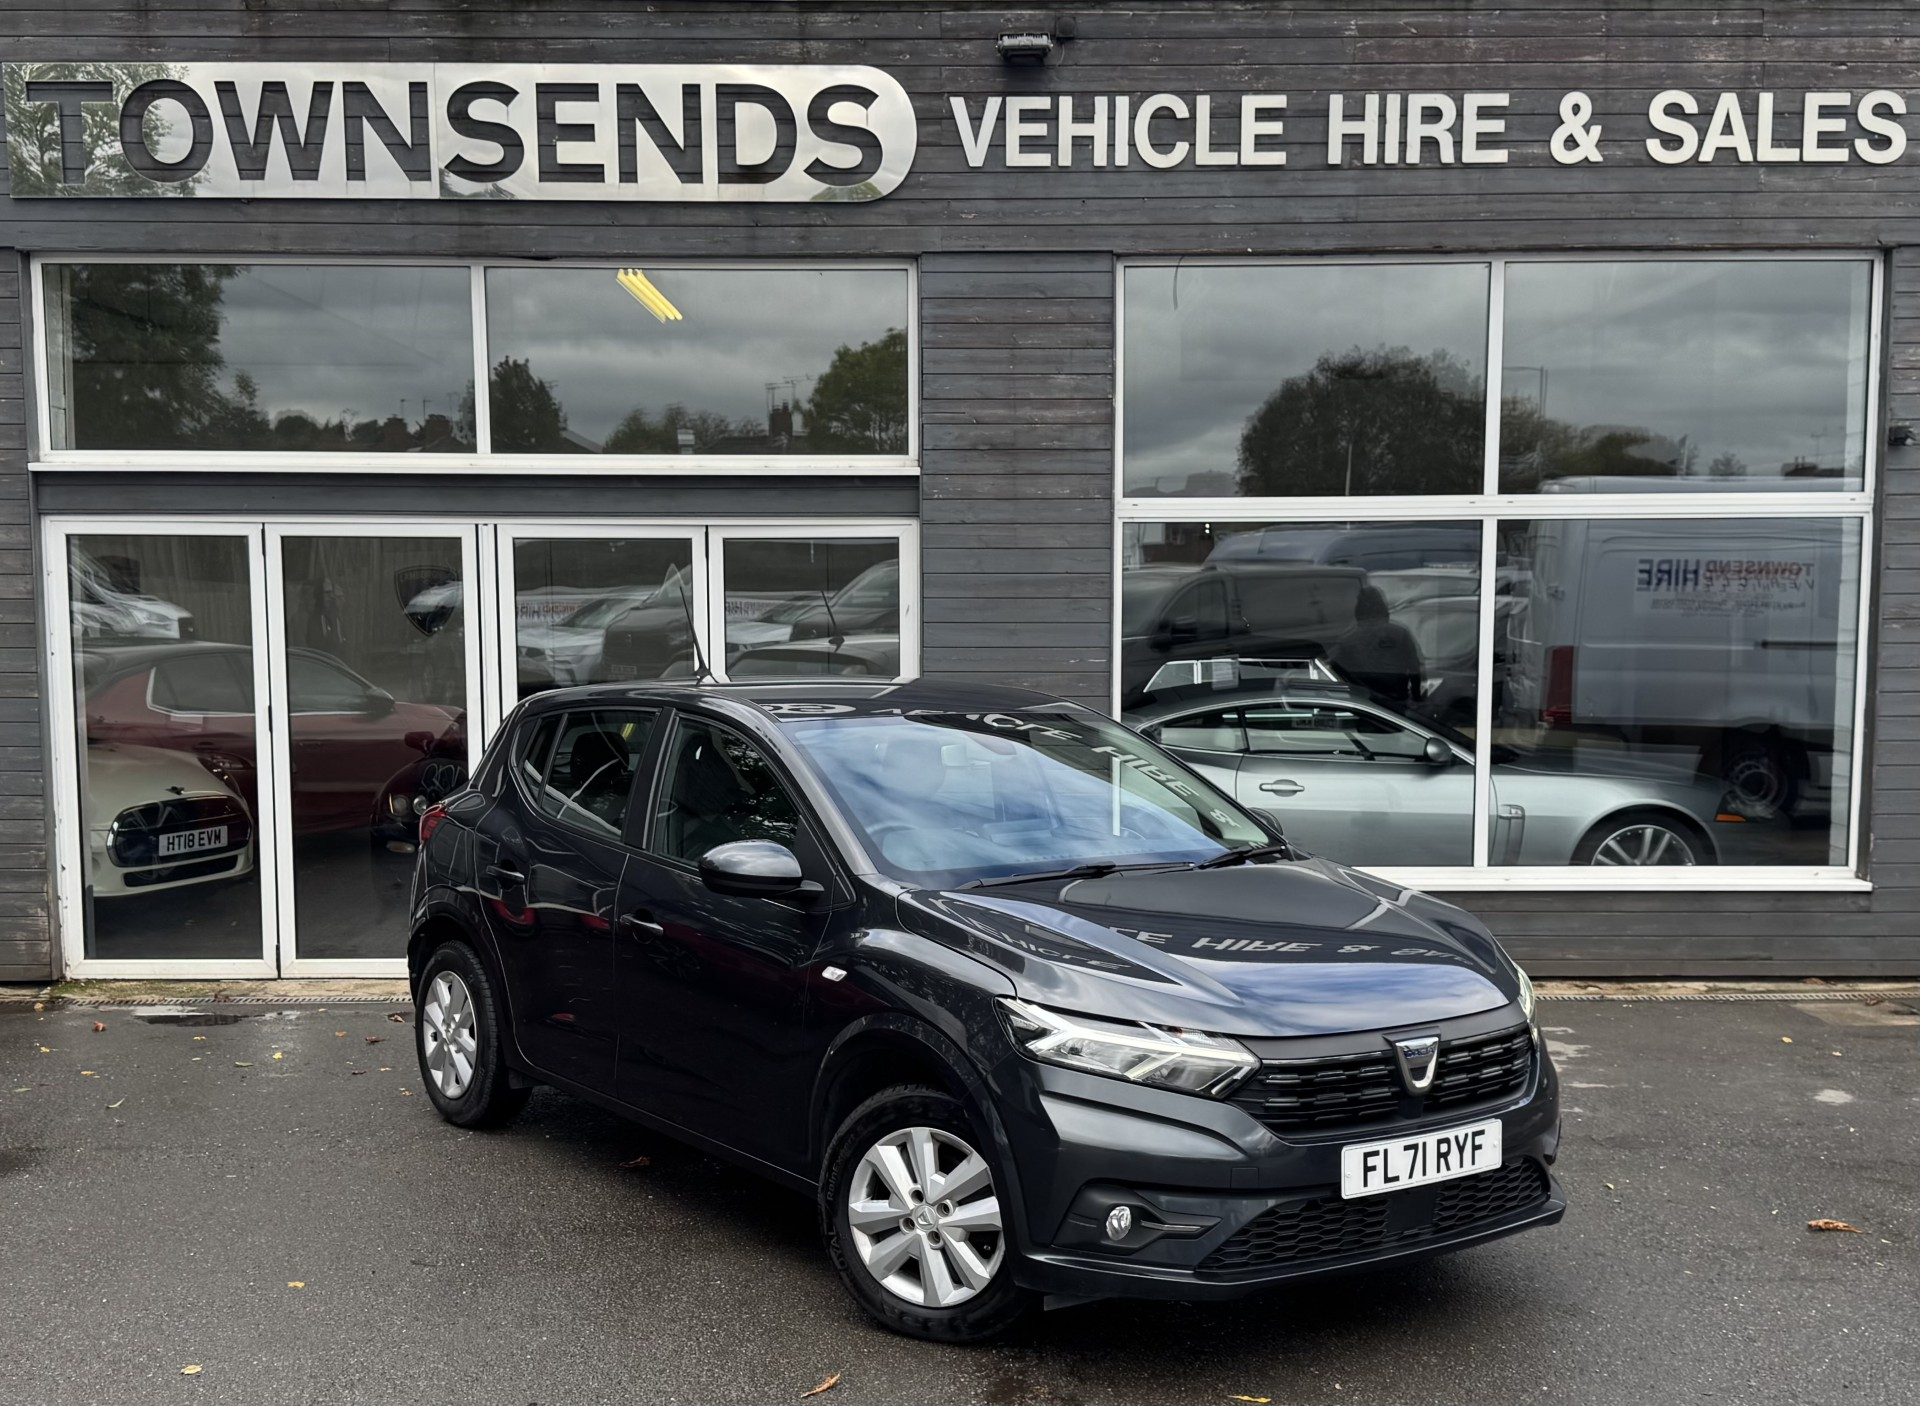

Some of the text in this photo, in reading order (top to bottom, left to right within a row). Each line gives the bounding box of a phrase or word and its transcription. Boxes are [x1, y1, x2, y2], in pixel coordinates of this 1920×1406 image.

[26, 80, 884, 185] TOWNSENDS
[948, 89, 1909, 169] VEHICLE HIRE & SALES
[166, 829, 222, 852] HT18 EVM
[1362, 1129, 1486, 1188] FL71 RYF
